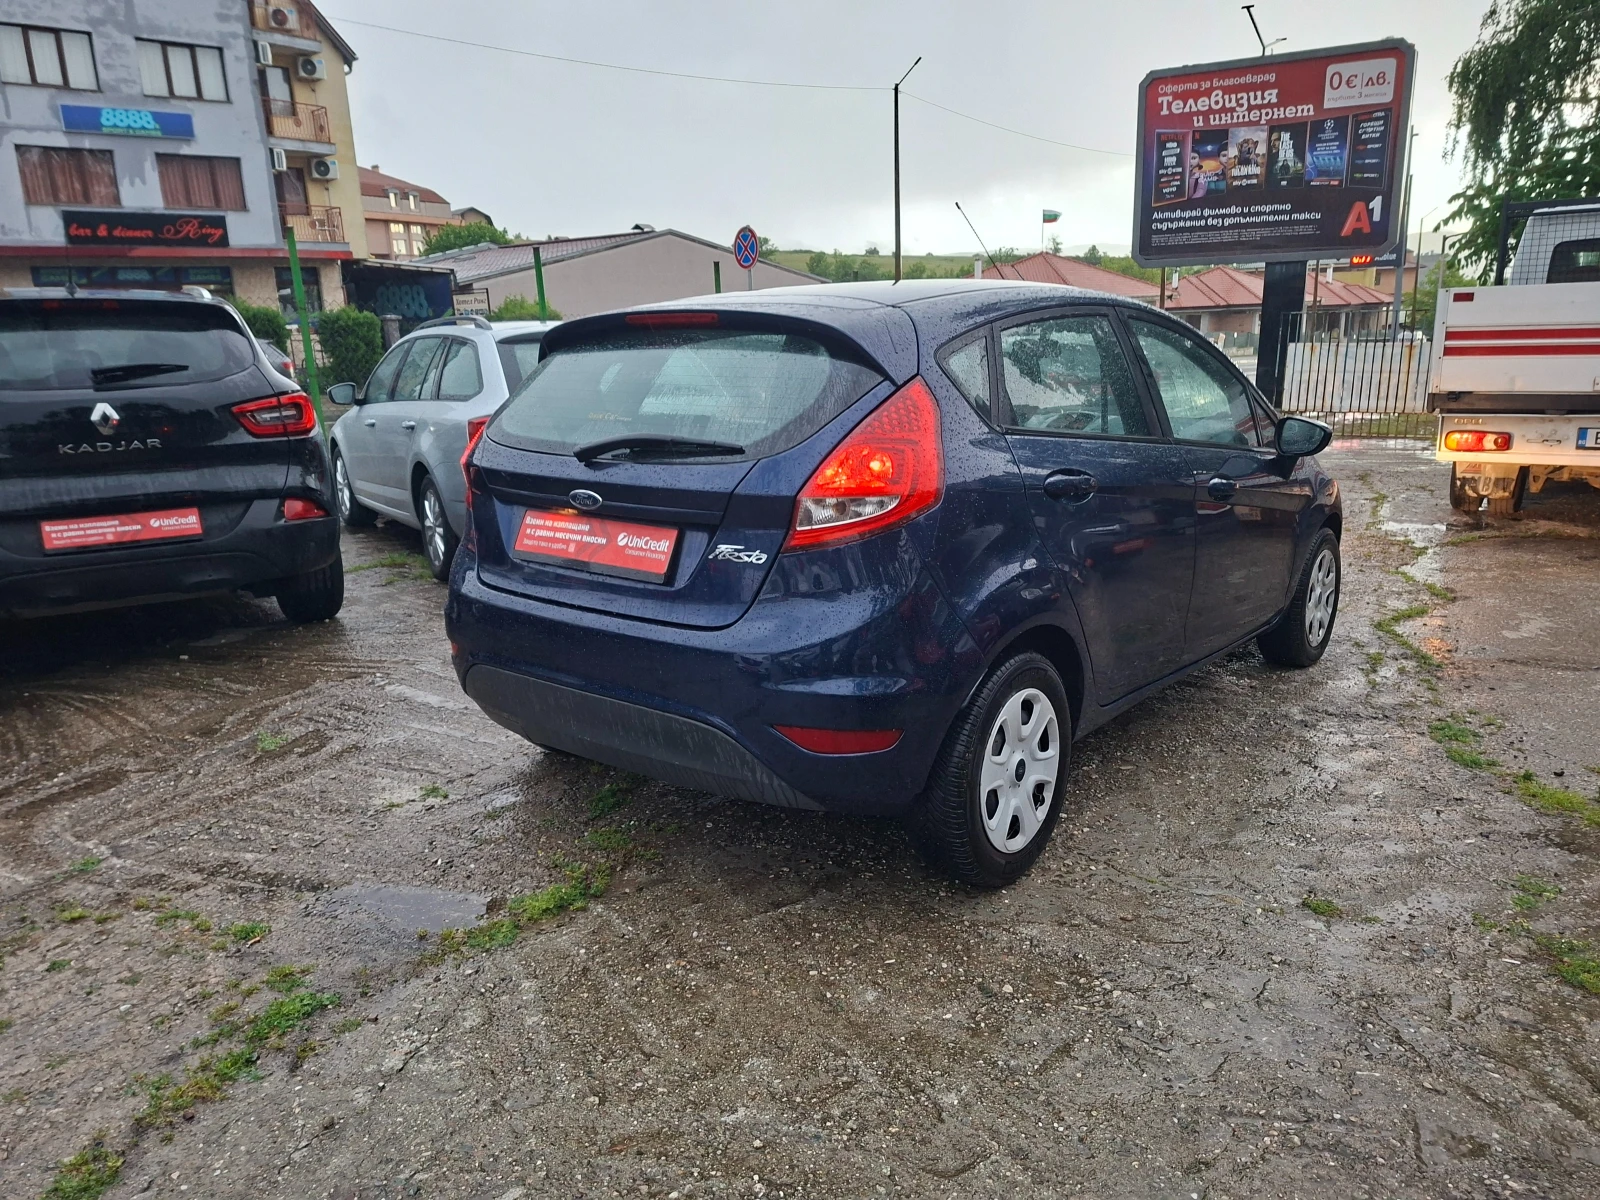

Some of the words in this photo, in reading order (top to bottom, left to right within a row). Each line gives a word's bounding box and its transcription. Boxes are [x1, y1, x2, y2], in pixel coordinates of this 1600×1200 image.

[1158, 82, 1198, 94] Оферта
[1200, 80, 1211, 90] за
[1213, 73, 1276, 88] Благоевград
[1158, 89, 1278, 115] Телевизия
[1357, 91, 1363, 99] 3
[100, 108, 156, 130] 8888
[1193, 115, 1204, 127] и
[1209, 103, 1314, 124] интернет
[1280, 131, 1291, 141] THE
[1279, 140, 1293, 150] LAST
[1152, 208, 1201, 220] Активирай
[1202, 205, 1242, 217] филмово
[1250, 203, 1292, 213] спортно
[1340, 195, 1383, 237] A1
[1152, 219, 1206, 231] съдържание
[1207, 216, 1223, 227] без
[1223, 214, 1290, 225] допълнителни
[1291, 212, 1322, 220] такси
[68, 223, 92, 237] bar
[96, 223, 109, 237] &
[112, 225, 154, 238] dinner
[157, 218, 225, 244] Ring
[58, 438, 162, 455] KADJAR
[575, 492, 594, 506] Ford
[116, 524, 142, 532] вноски
[160, 515, 197, 526] UniCredit
[525, 516, 545, 526] Вземи
[553, 520, 590, 531] изплащане
[535, 529, 554, 538] равни
[555, 531, 581, 541] месечни
[582, 535, 607, 545] вноски
[628, 533, 670, 553] UniCredit
[708, 544, 768, 564] Fiesta
